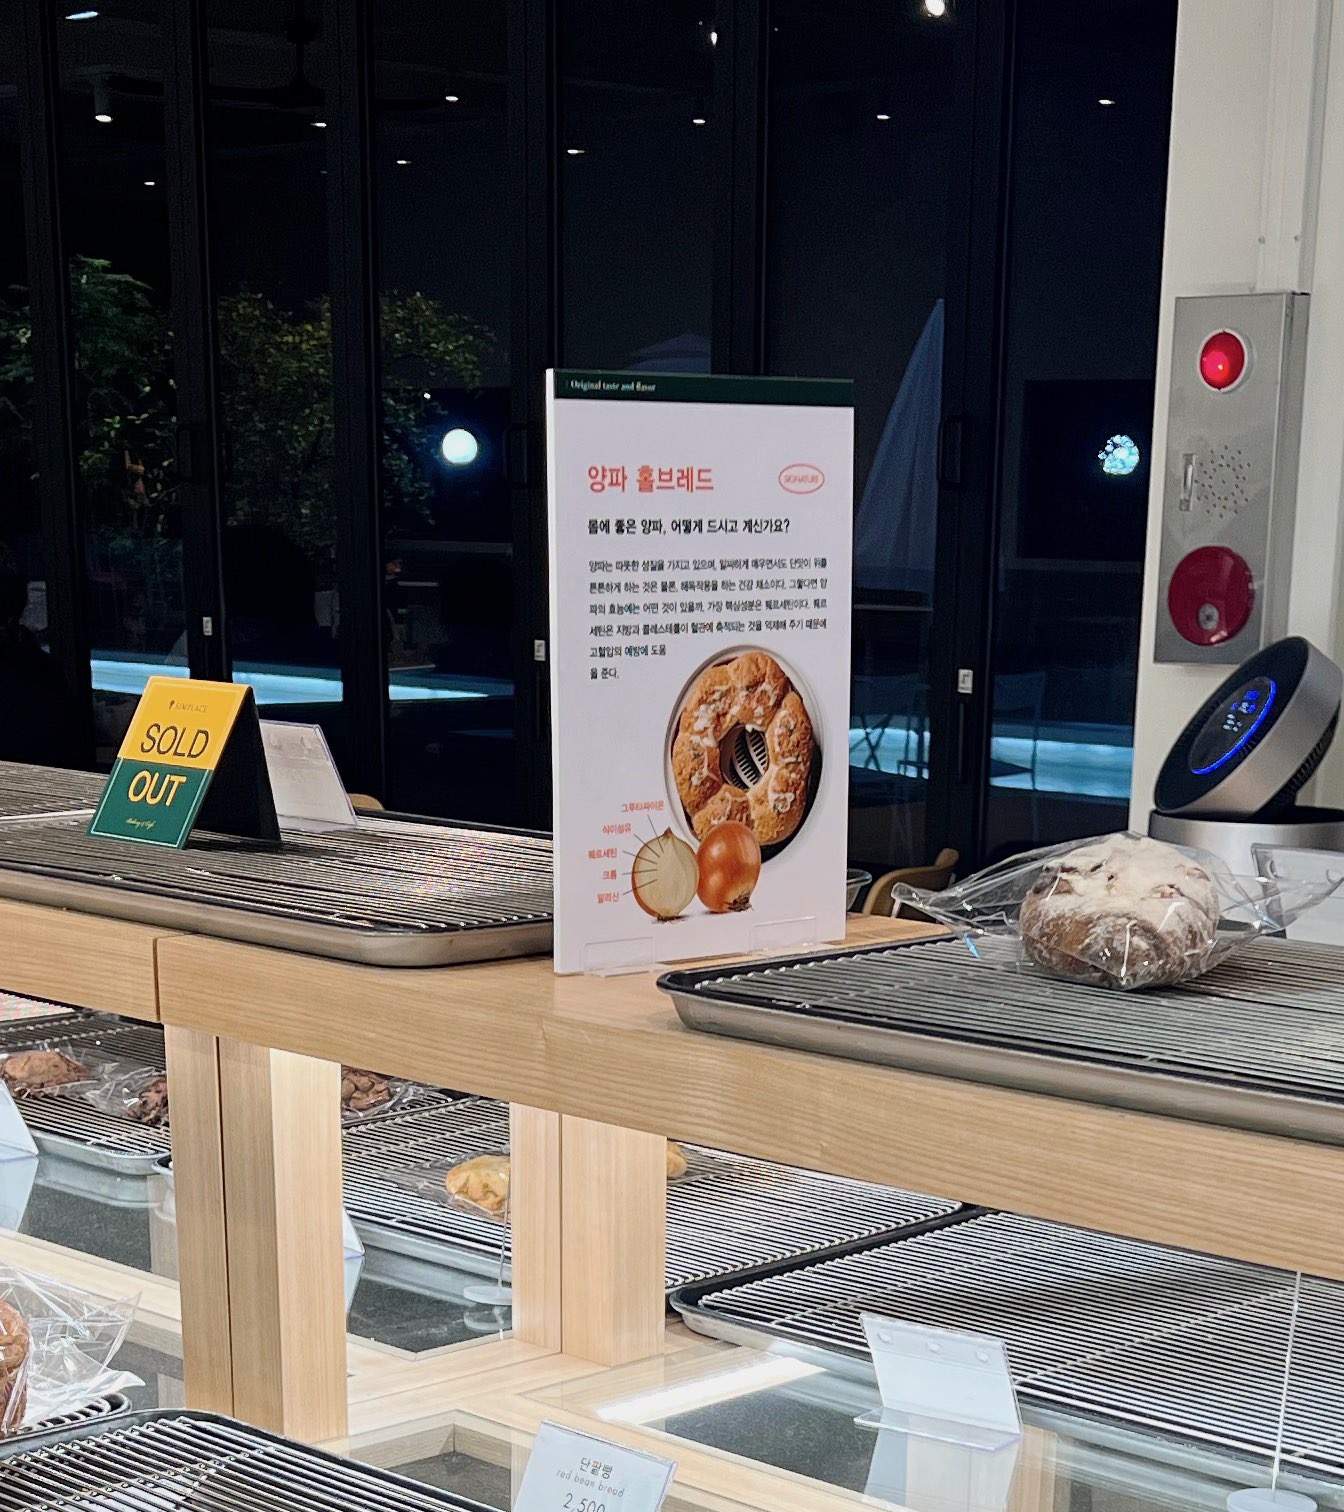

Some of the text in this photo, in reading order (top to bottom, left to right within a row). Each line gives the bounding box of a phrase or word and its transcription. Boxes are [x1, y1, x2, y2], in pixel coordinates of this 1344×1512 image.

[571, 380, 601, 393] Original
[621, 382, 635, 391] and
[588, 465, 714, 494] 양파 홀브레드
[588, 517, 790, 535] 몸에 좋은 양파, 어떻게 드시고 계신가요?
[589, 561, 612, 572] 양파는
[667, 560, 689, 570] 가지고
[624, 582, 639, 593] 하는
[643, 581, 657, 593] 것은
[721, 580, 736, 591] 하는
[739, 580, 753, 591] 건강
[662, 602, 677, 613] 것이
[708, 601, 723, 613] 가장
[748, 621, 762, 632] 것을
[789, 619, 803, 630] 주기
[651, 645, 666, 656] 도움
[140, 723, 209, 758] SOLD
[128, 770, 187, 806] OUT
[580, 1457, 614, 1479] 단팥빵
[556, 1469, 625, 1498] red bean bread
